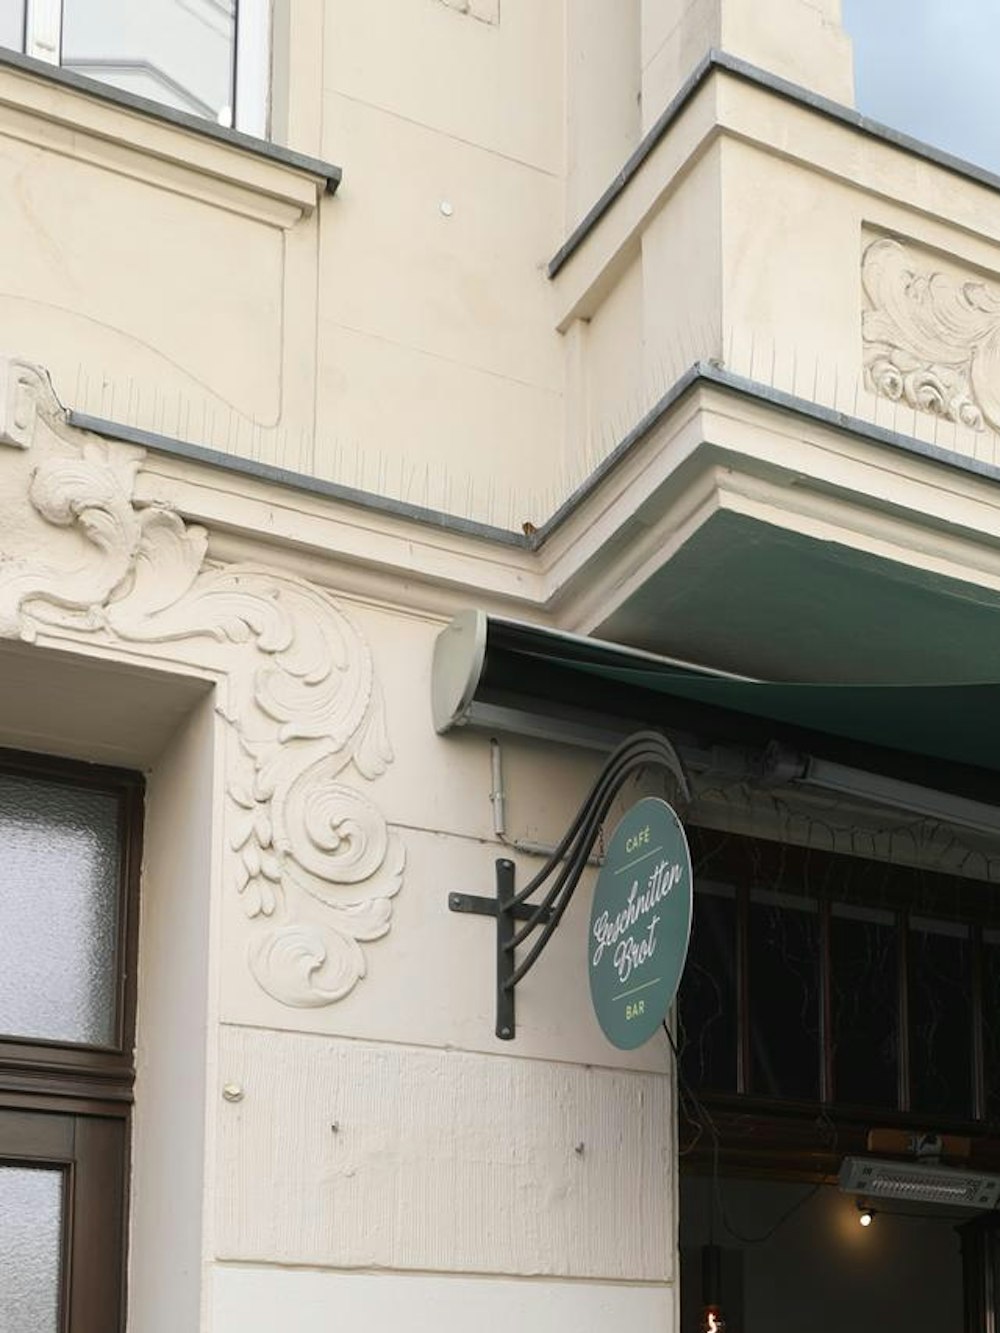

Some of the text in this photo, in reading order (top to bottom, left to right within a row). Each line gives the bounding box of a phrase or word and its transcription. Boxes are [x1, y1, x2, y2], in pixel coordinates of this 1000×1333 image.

[626, 825, 651, 853] CAFÉ
[593, 859, 683, 966] Geschnitten
[613, 914, 661, 983] Brot
[625, 1000, 646, 1021] BAR
